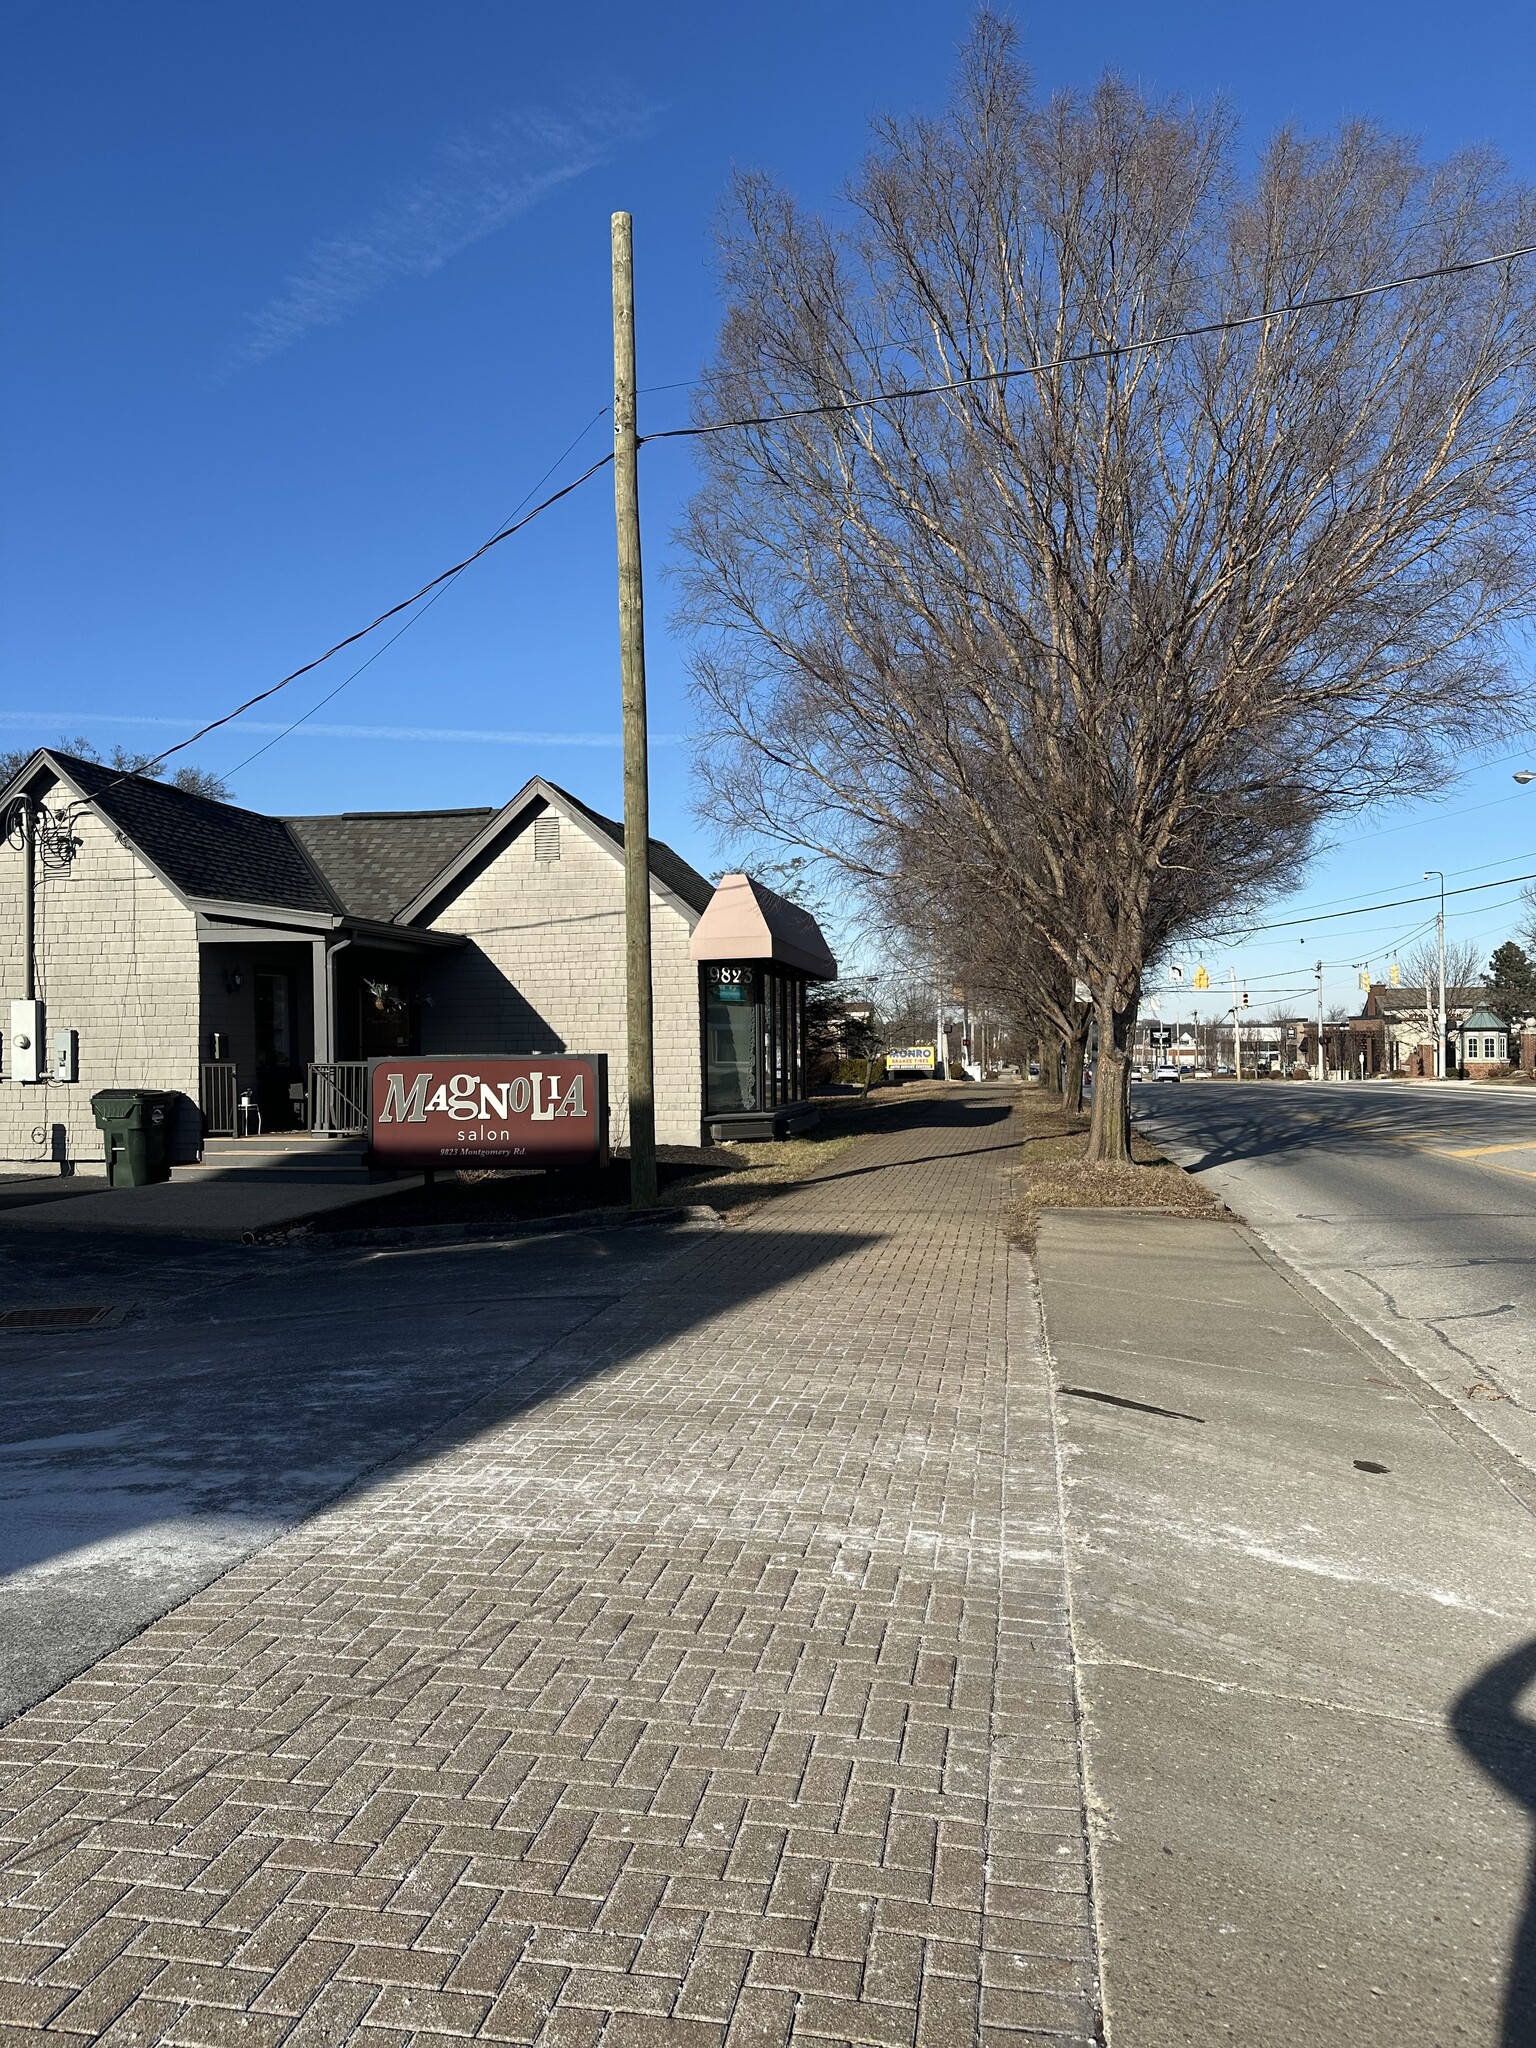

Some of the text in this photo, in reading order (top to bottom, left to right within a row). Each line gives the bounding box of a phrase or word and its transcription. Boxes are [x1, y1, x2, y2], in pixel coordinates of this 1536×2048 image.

[710, 966, 753, 984] 9823
[890, 1048, 932, 1058] MONRO
[457, 1124, 510, 1141] salon
[440, 1147, 527, 1157] 9823 Montgomery Rd.
